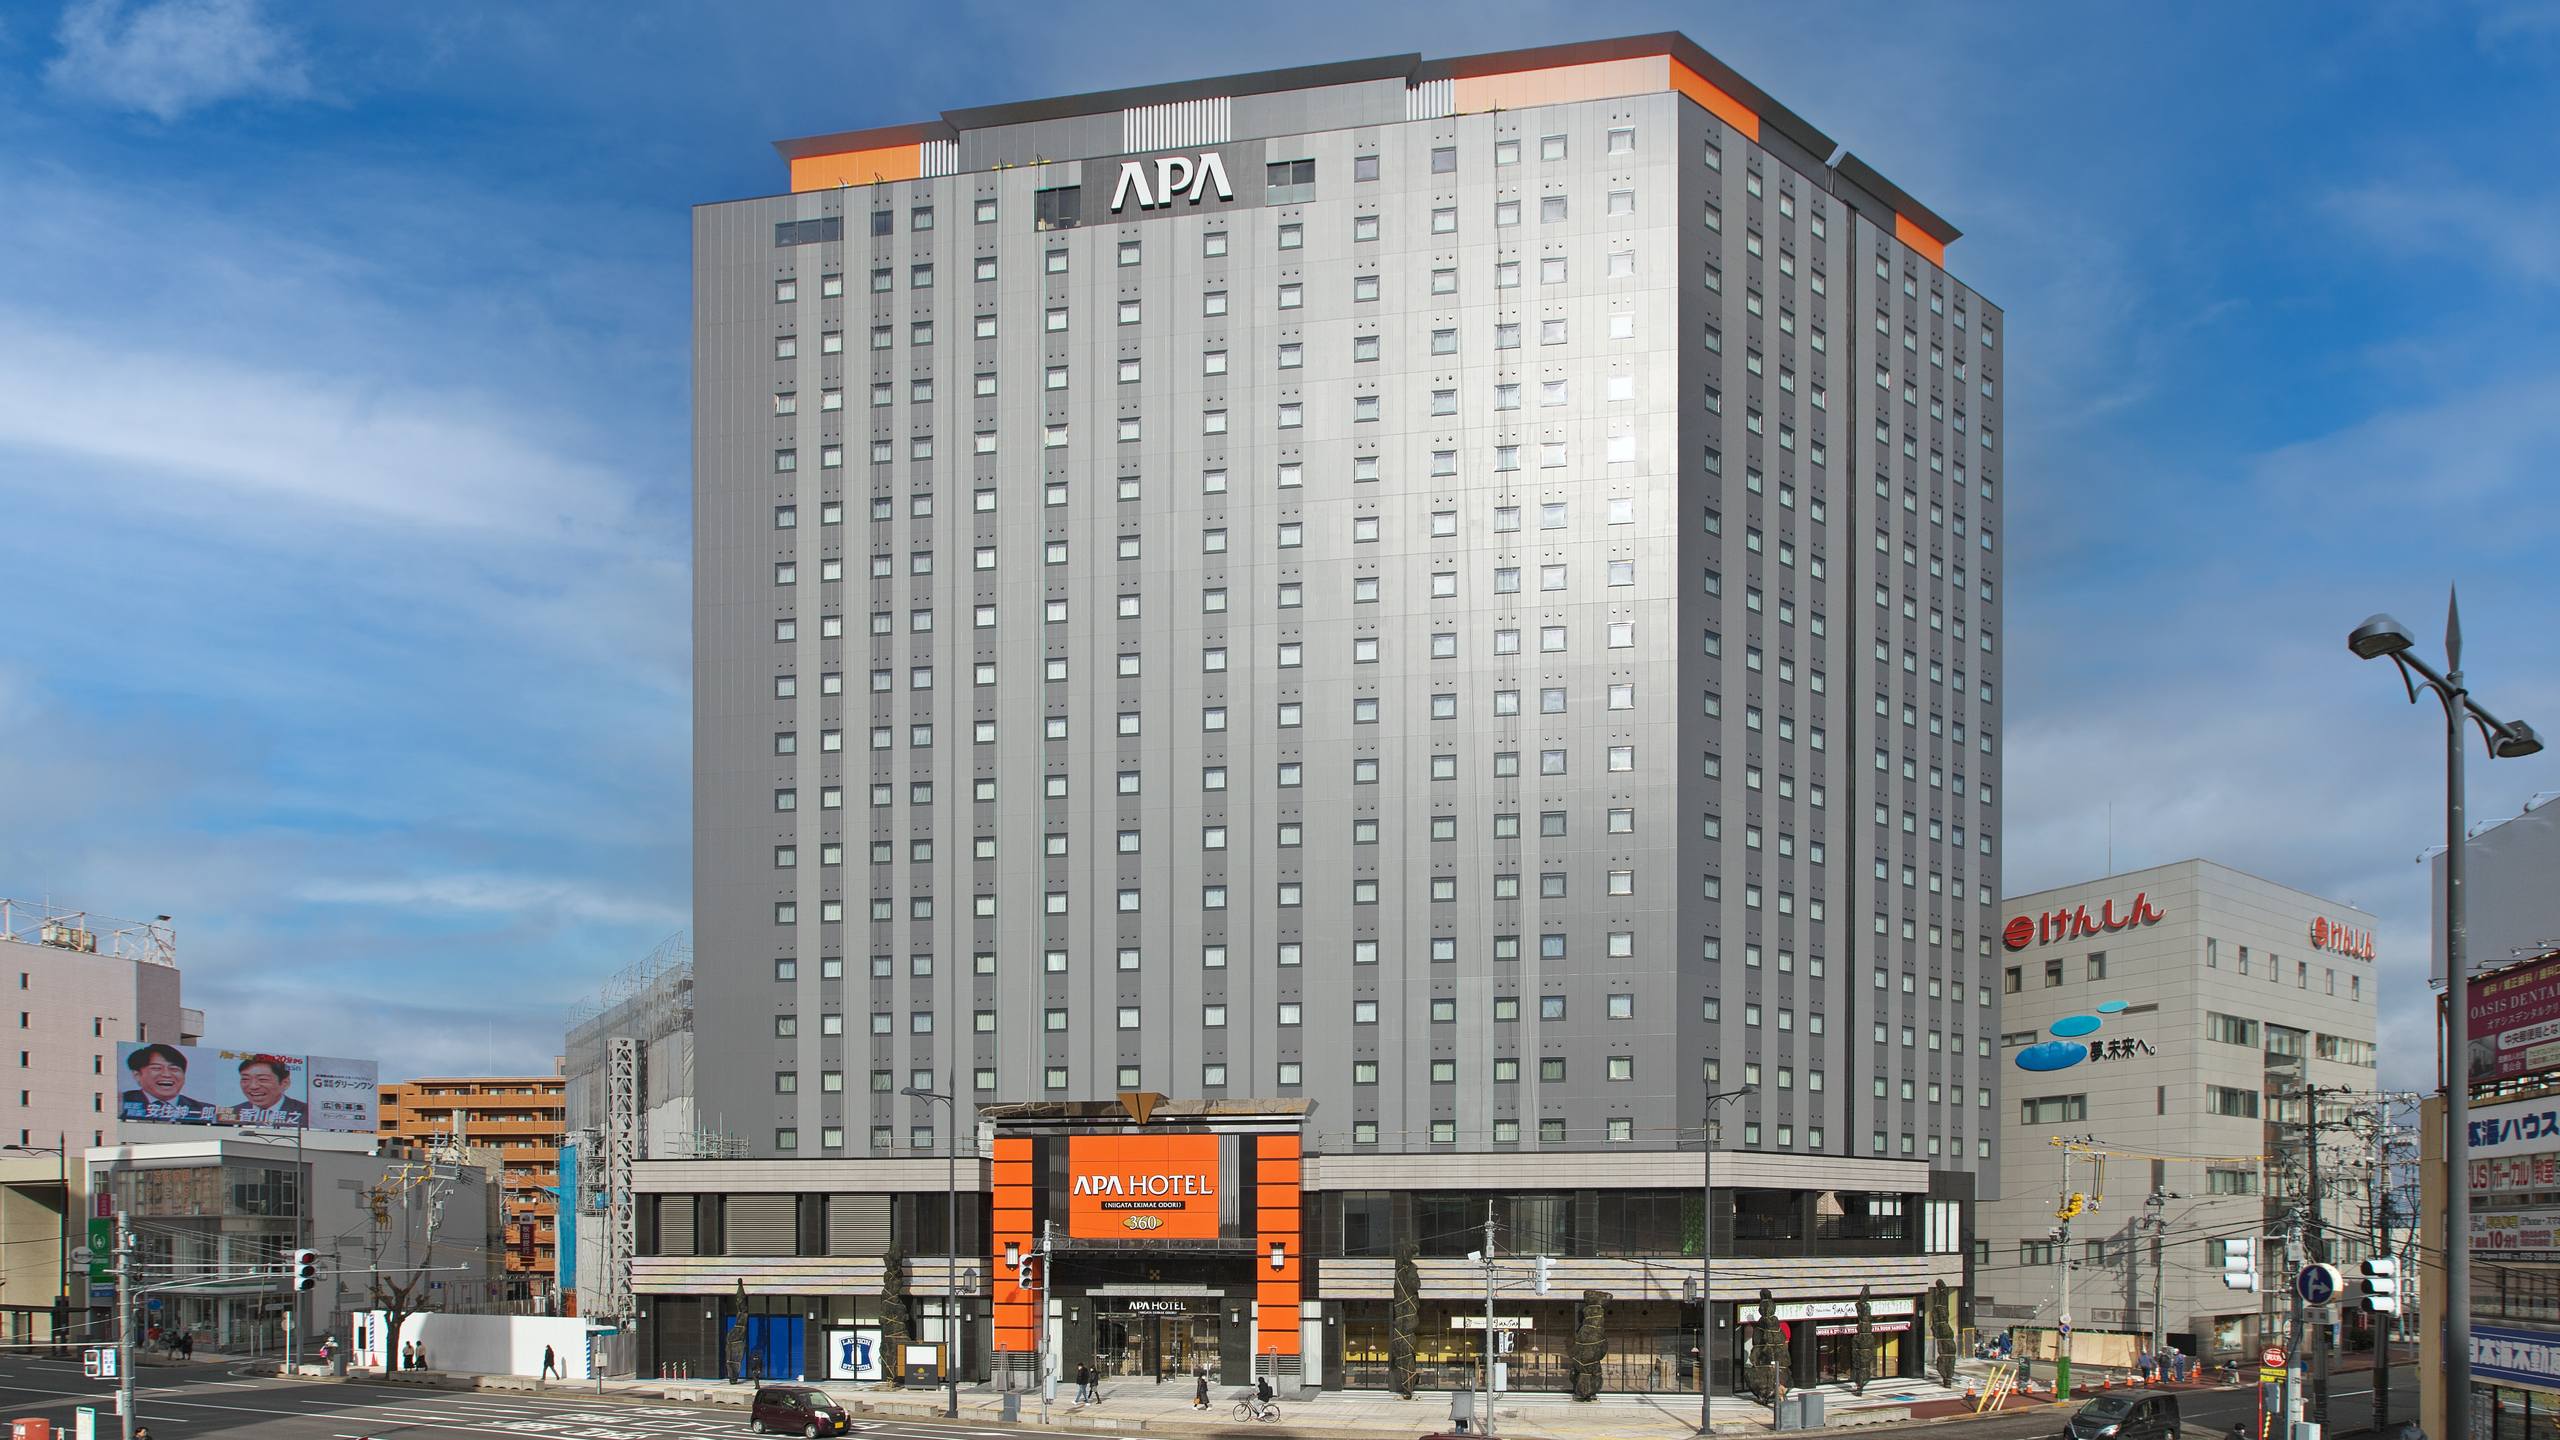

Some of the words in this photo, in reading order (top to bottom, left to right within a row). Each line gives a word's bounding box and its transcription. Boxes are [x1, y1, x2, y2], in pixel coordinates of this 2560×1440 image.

[1111, 152, 1233, 214] APA
[2041, 892, 2167, 943] けんしん
[2328, 921, 2376, 961] けんしん
[2471, 998, 2507, 1019] OASIS
[1073, 1175, 1124, 1196] APA
[1129, 1174, 1214, 1196] HOTEL
[2468, 1164, 2487, 1189] US
[1129, 1215, 1157, 1230] 360
[1128, 1301, 1150, 1310] APA
[1151, 1301, 1187, 1311] HOTEL
[842, 1363, 871, 1371] STAION
